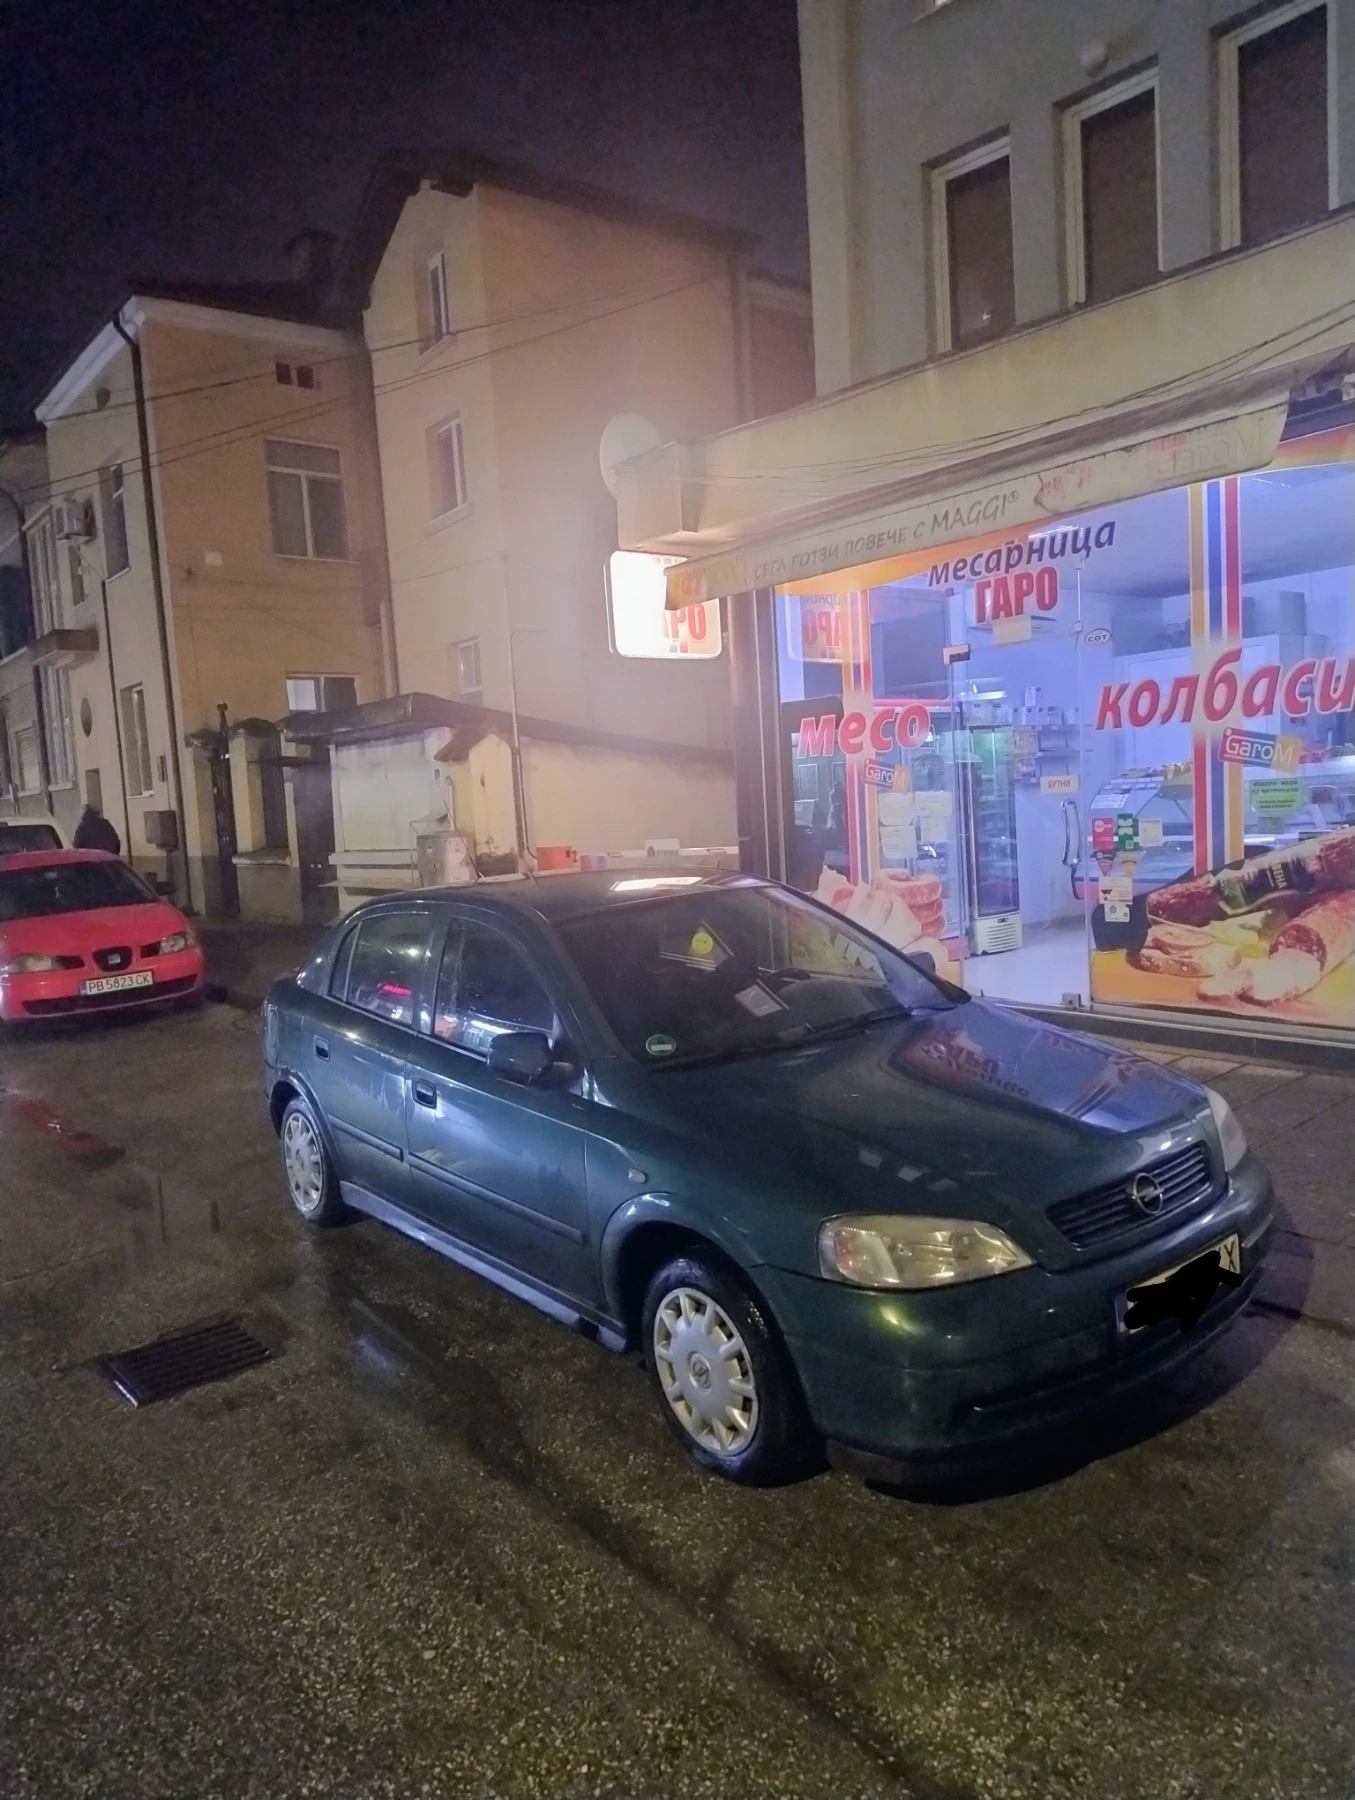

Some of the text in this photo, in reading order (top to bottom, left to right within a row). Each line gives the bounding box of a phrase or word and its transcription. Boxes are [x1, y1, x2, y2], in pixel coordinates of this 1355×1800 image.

[754, 559, 787, 580] СЕГА
[844, 526, 909, 556] ПОВЕЧЕ
[928, 520, 1116, 588] месарница
[975, 565, 1058, 624] ГАРО
[1095, 646, 1355, 731] колбаси
[796, 703, 930, 760] месо
[1224, 735, 1295, 768] GaroM
[1047, 779, 1072, 789] БУТНИ
[106, 976, 134, 990] 5823
